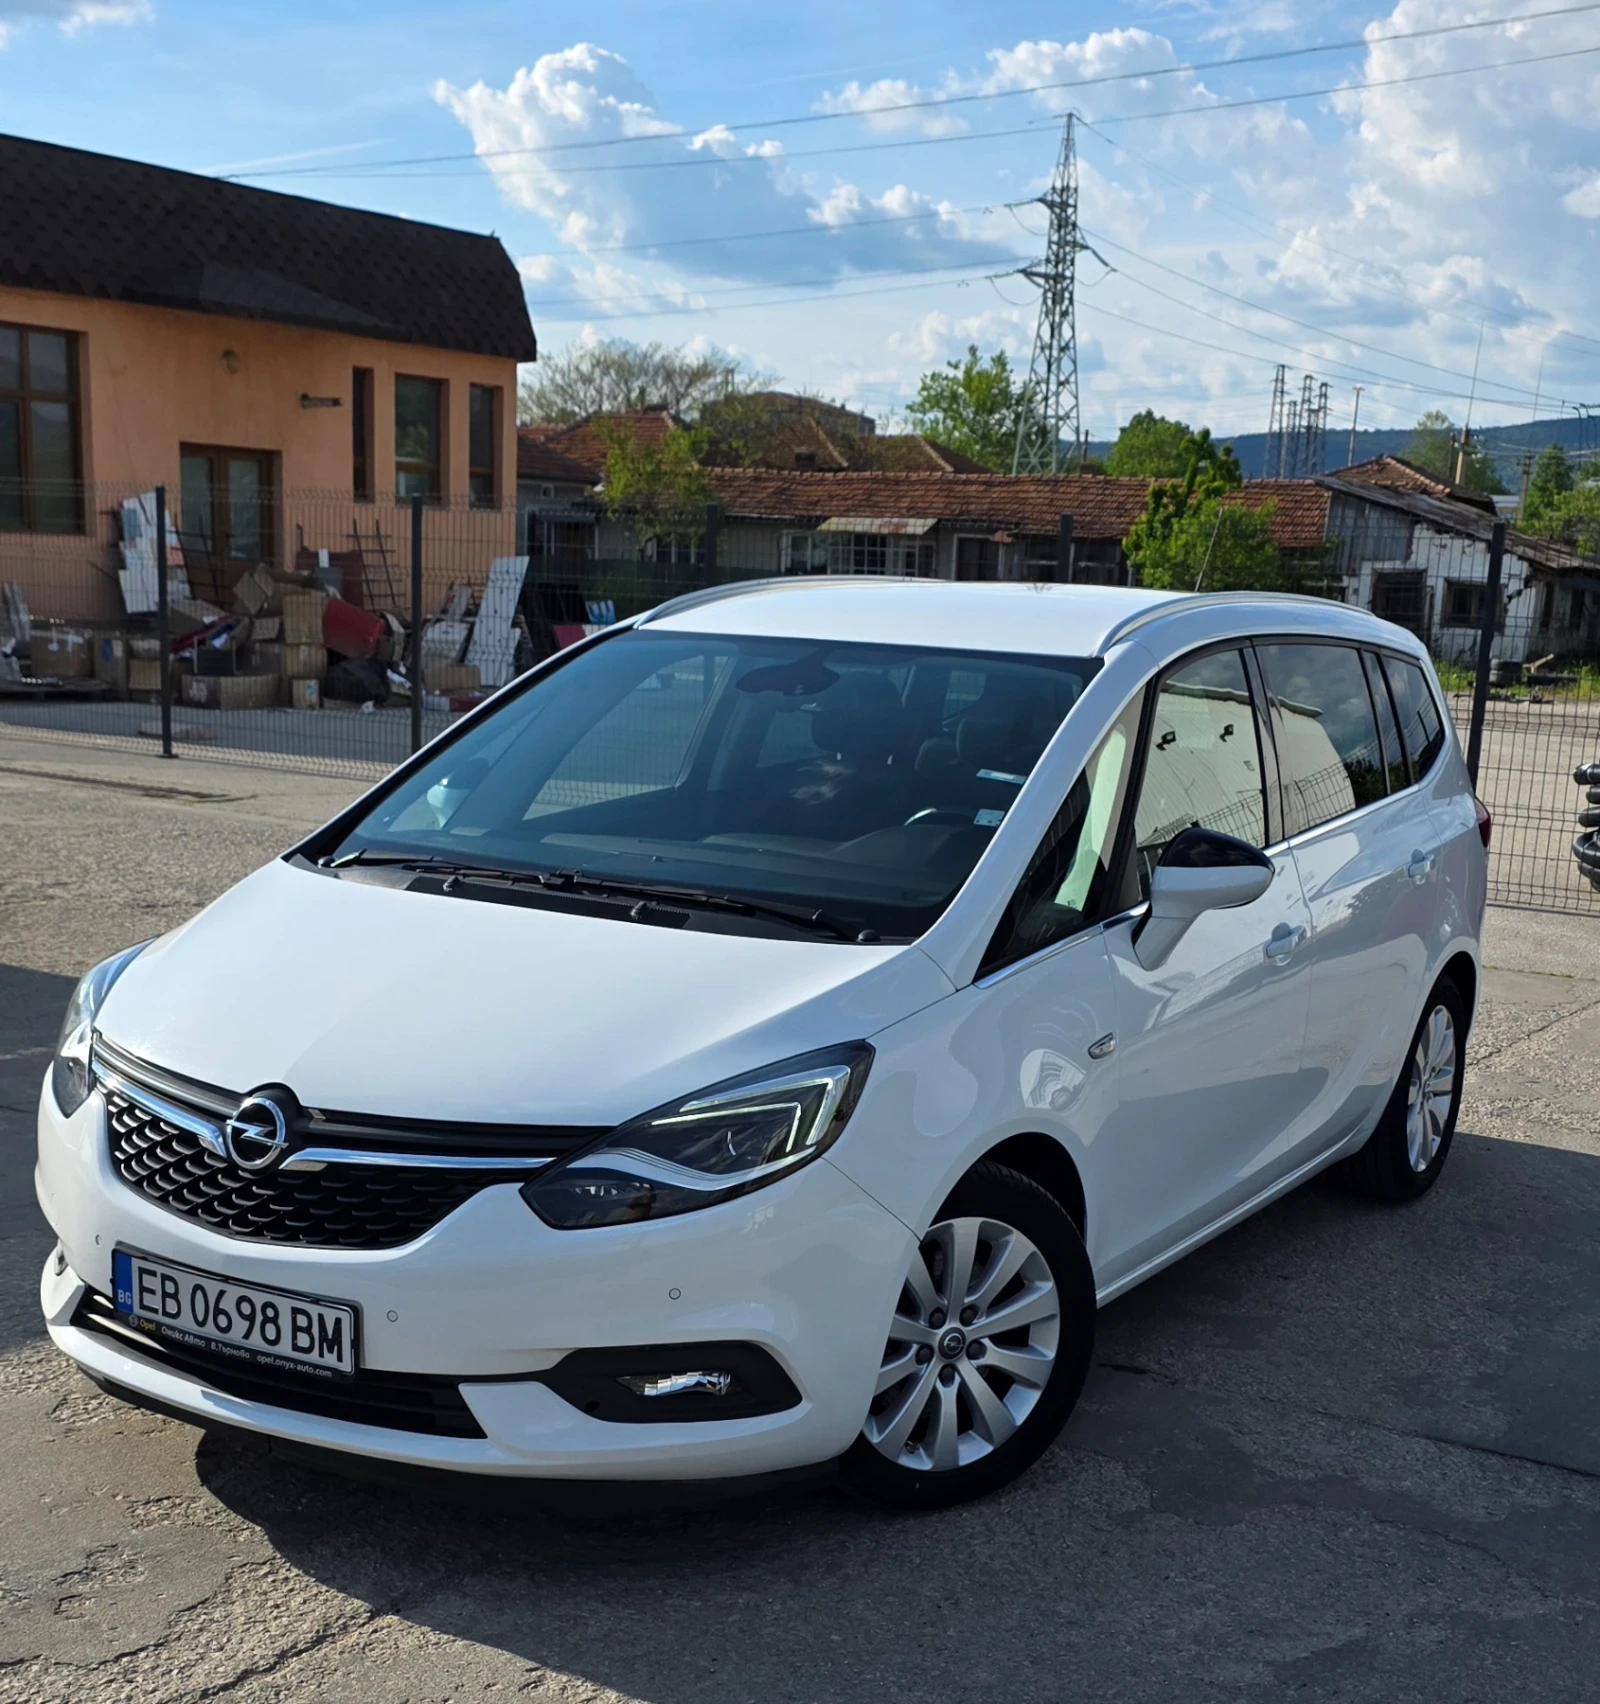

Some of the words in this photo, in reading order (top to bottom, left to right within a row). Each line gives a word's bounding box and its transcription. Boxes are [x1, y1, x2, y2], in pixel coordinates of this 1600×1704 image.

[118, 1289, 132, 1304] BG
[138, 1266, 182, 1320] EB
[190, 1283, 282, 1347] 0698
[290, 1306, 343, 1363] BM
[139, 1319, 156, 1332] Opel
[256, 1353, 333, 1378] opel.onyx-auto.com
